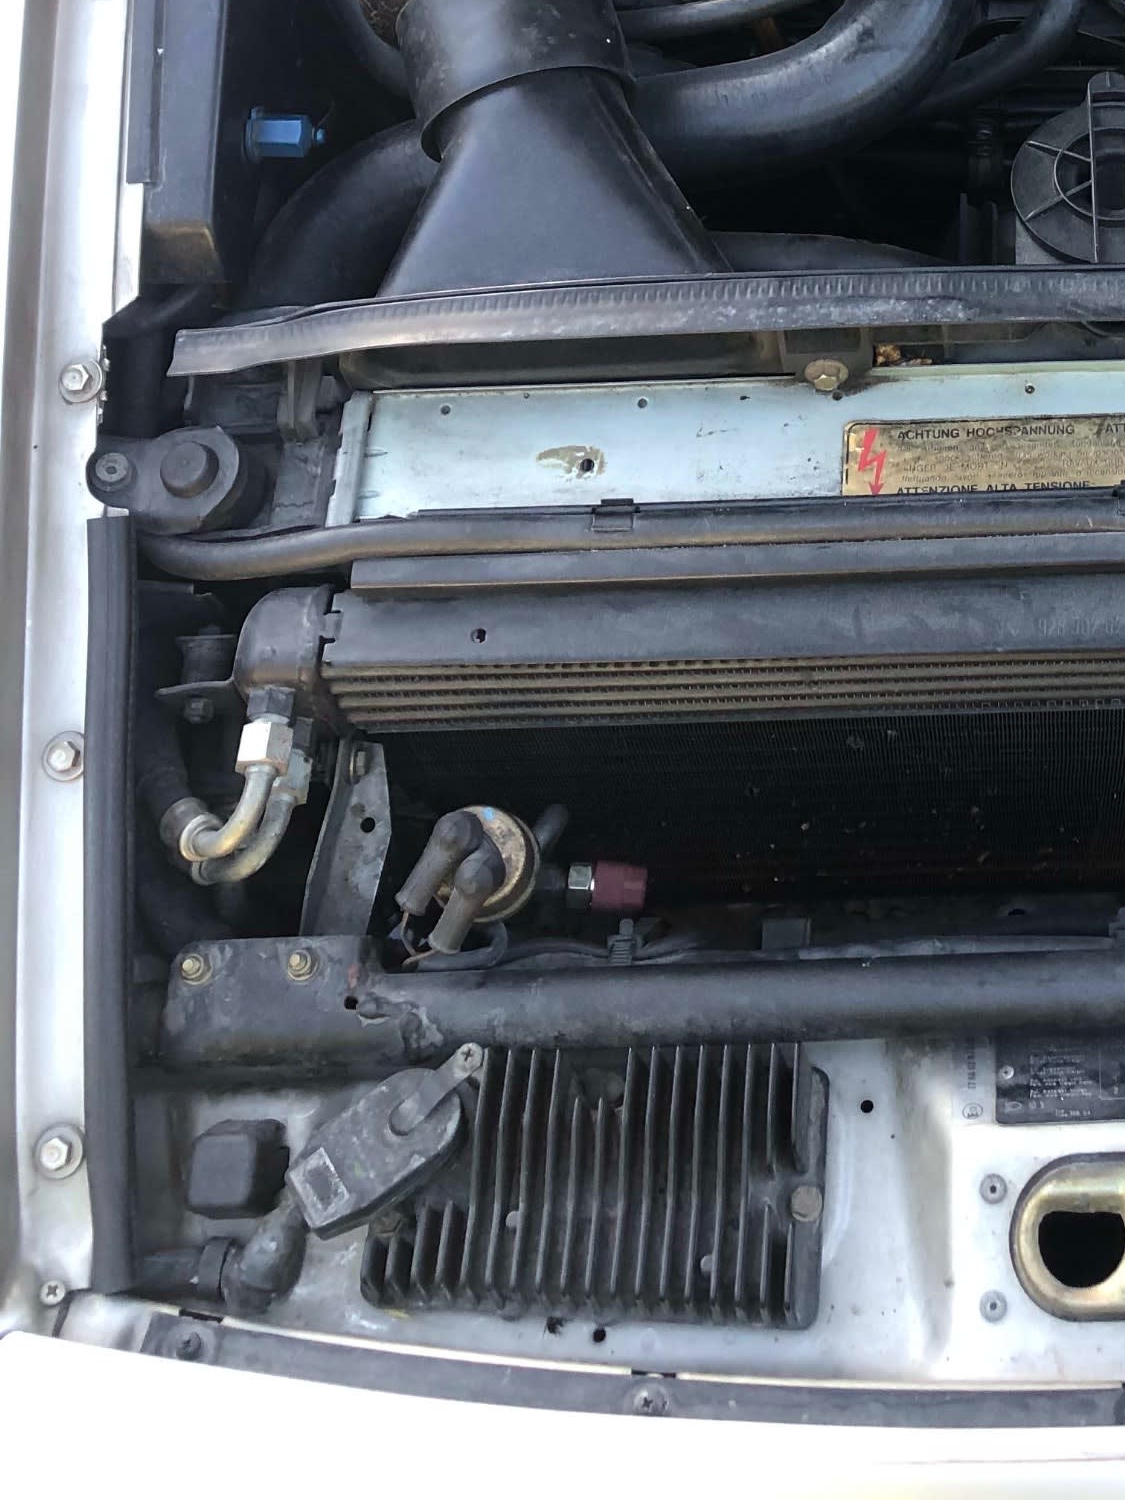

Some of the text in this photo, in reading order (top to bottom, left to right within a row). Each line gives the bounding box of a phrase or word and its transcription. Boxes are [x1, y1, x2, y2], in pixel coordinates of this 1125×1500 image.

[897, 428, 960, 442] ACHTUNG
[897, 484, 979, 495] ATTENZIONE
[986, 482, 1016, 493] ALTA
[1024, 480, 1091, 491] TENSIONE
